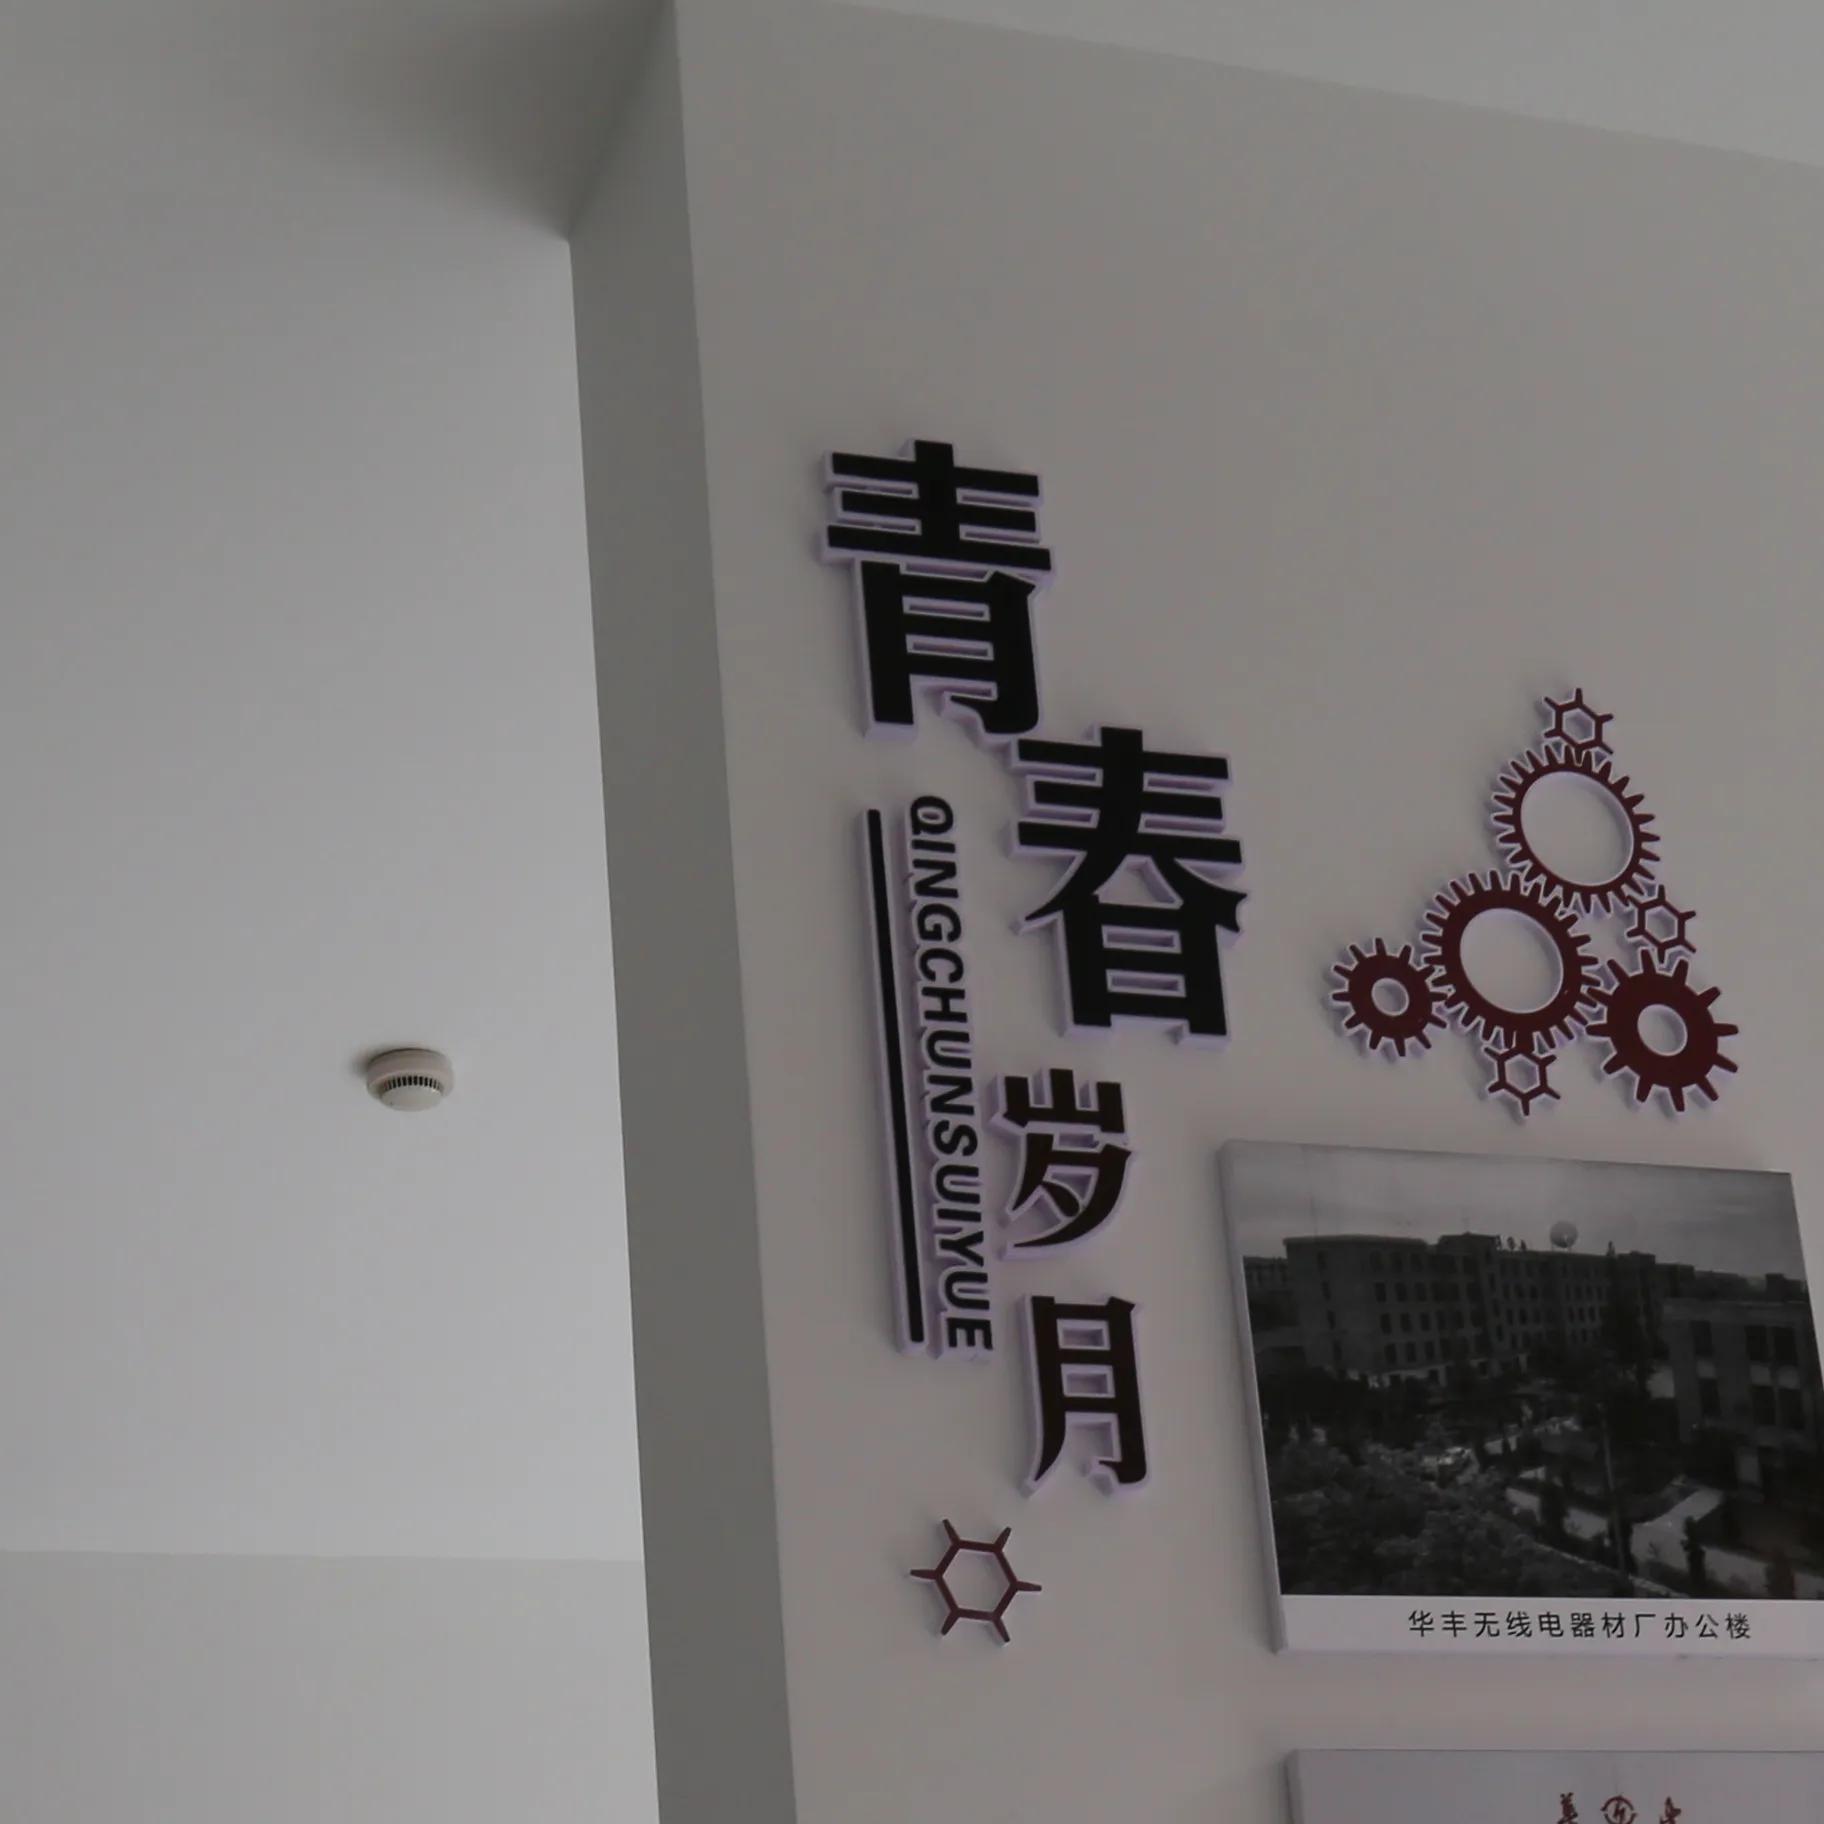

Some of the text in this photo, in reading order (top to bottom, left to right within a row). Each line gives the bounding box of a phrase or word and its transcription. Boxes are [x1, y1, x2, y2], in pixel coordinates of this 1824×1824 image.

[826, 440, 1247, 1486] 青春岁月
[909, 796, 993, 1353] QINGCHUNSUIYUE
[1407, 1609, 1752, 1640] 华丰无线电器材厂办公楼
